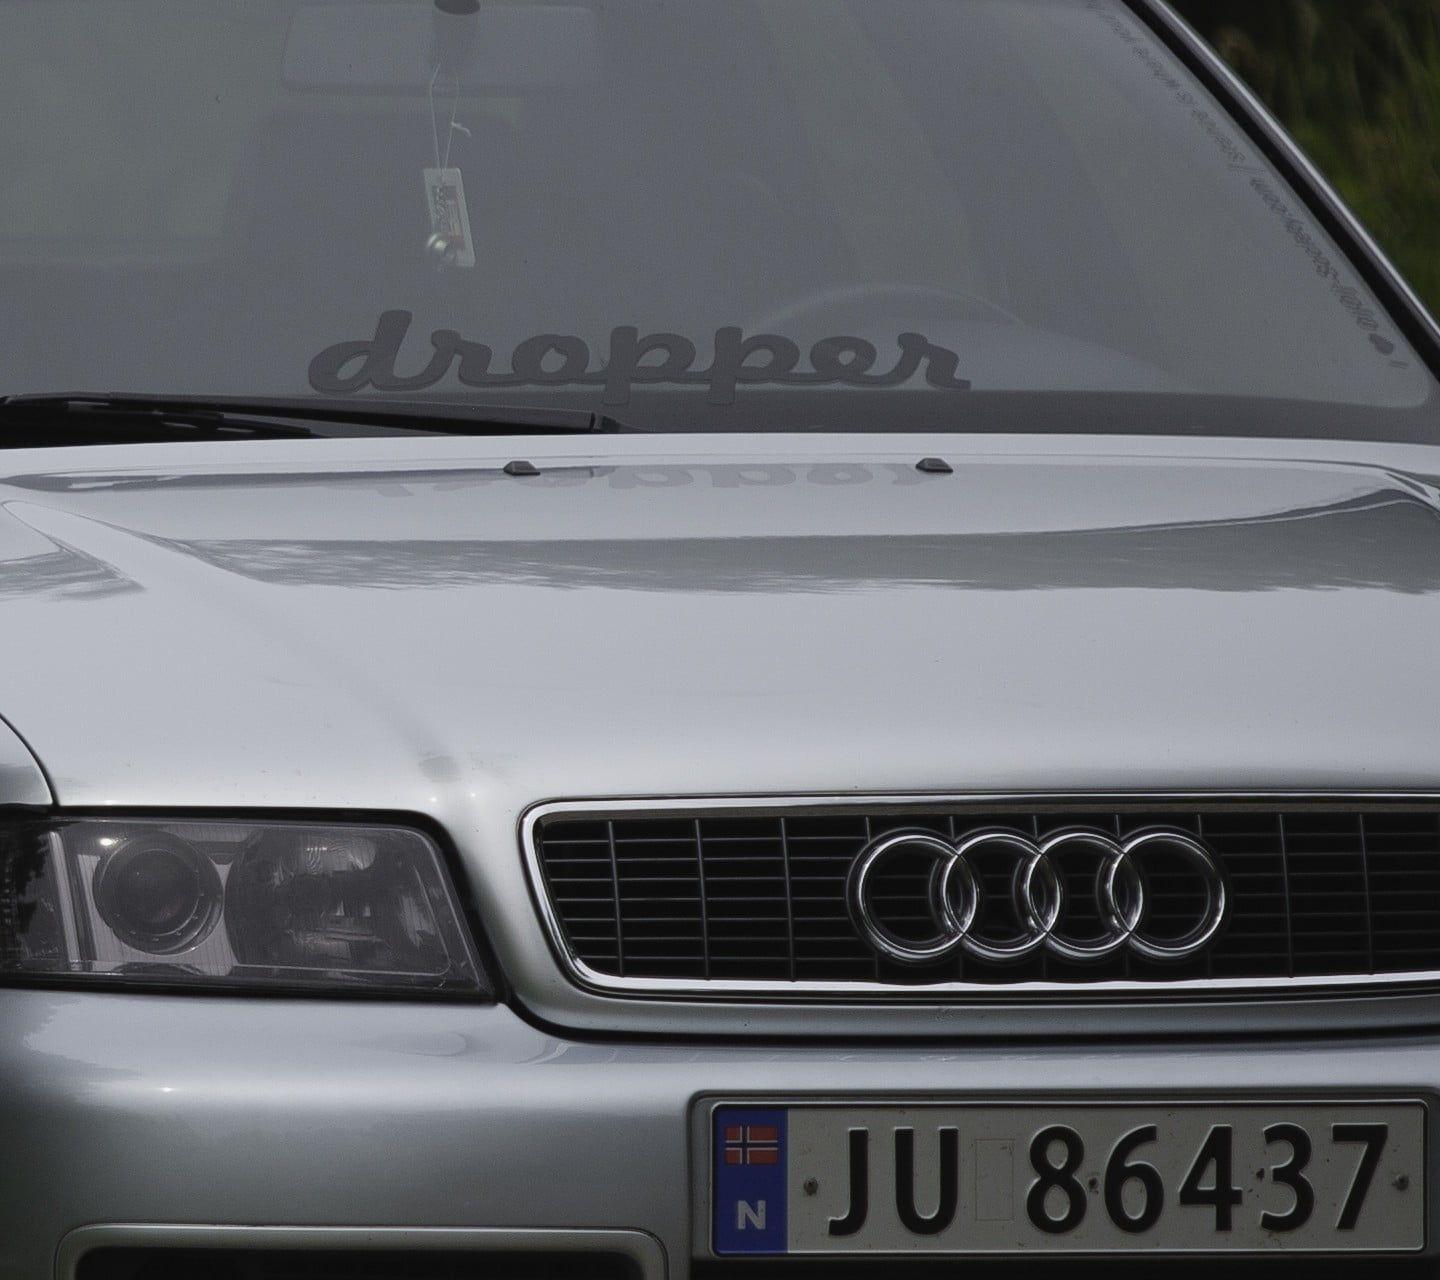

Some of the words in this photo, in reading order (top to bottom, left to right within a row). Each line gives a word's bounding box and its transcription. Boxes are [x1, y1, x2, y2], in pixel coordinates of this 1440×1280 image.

[308, 310, 971, 404] dropper
[737, 1200, 766, 1230] N
[828, 1127, 959, 1236] JU
[1026, 1124, 1389, 1234] 86437
